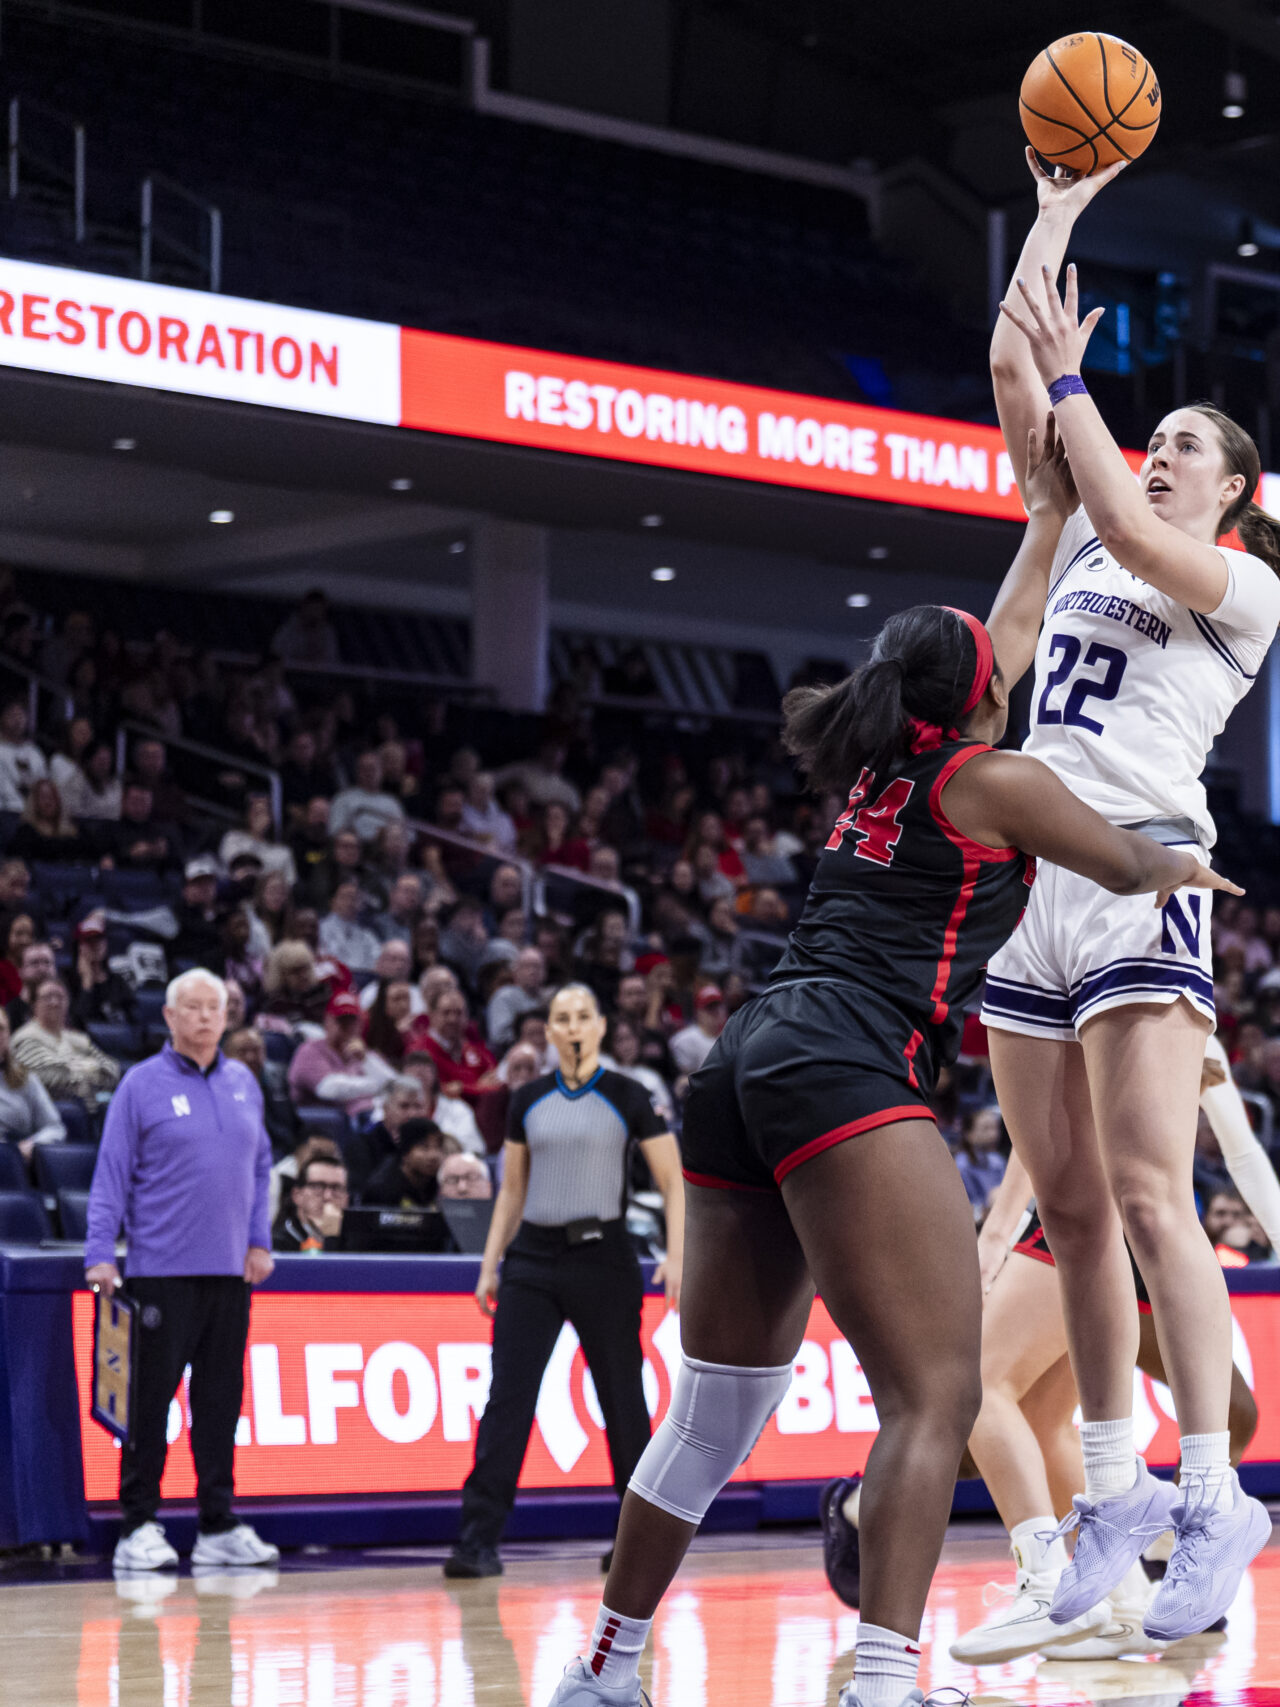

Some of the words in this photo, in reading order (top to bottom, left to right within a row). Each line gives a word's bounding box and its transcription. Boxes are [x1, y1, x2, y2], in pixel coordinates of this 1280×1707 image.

[503, 370, 747, 455] RESTORING
[756, 412, 878, 475] MORE
[884, 433, 988, 493] THAN
[1048, 590, 1172, 649] NORTHWESTERN
[1037, 633, 1128, 736] 22
[1161, 892, 1201, 959] N
